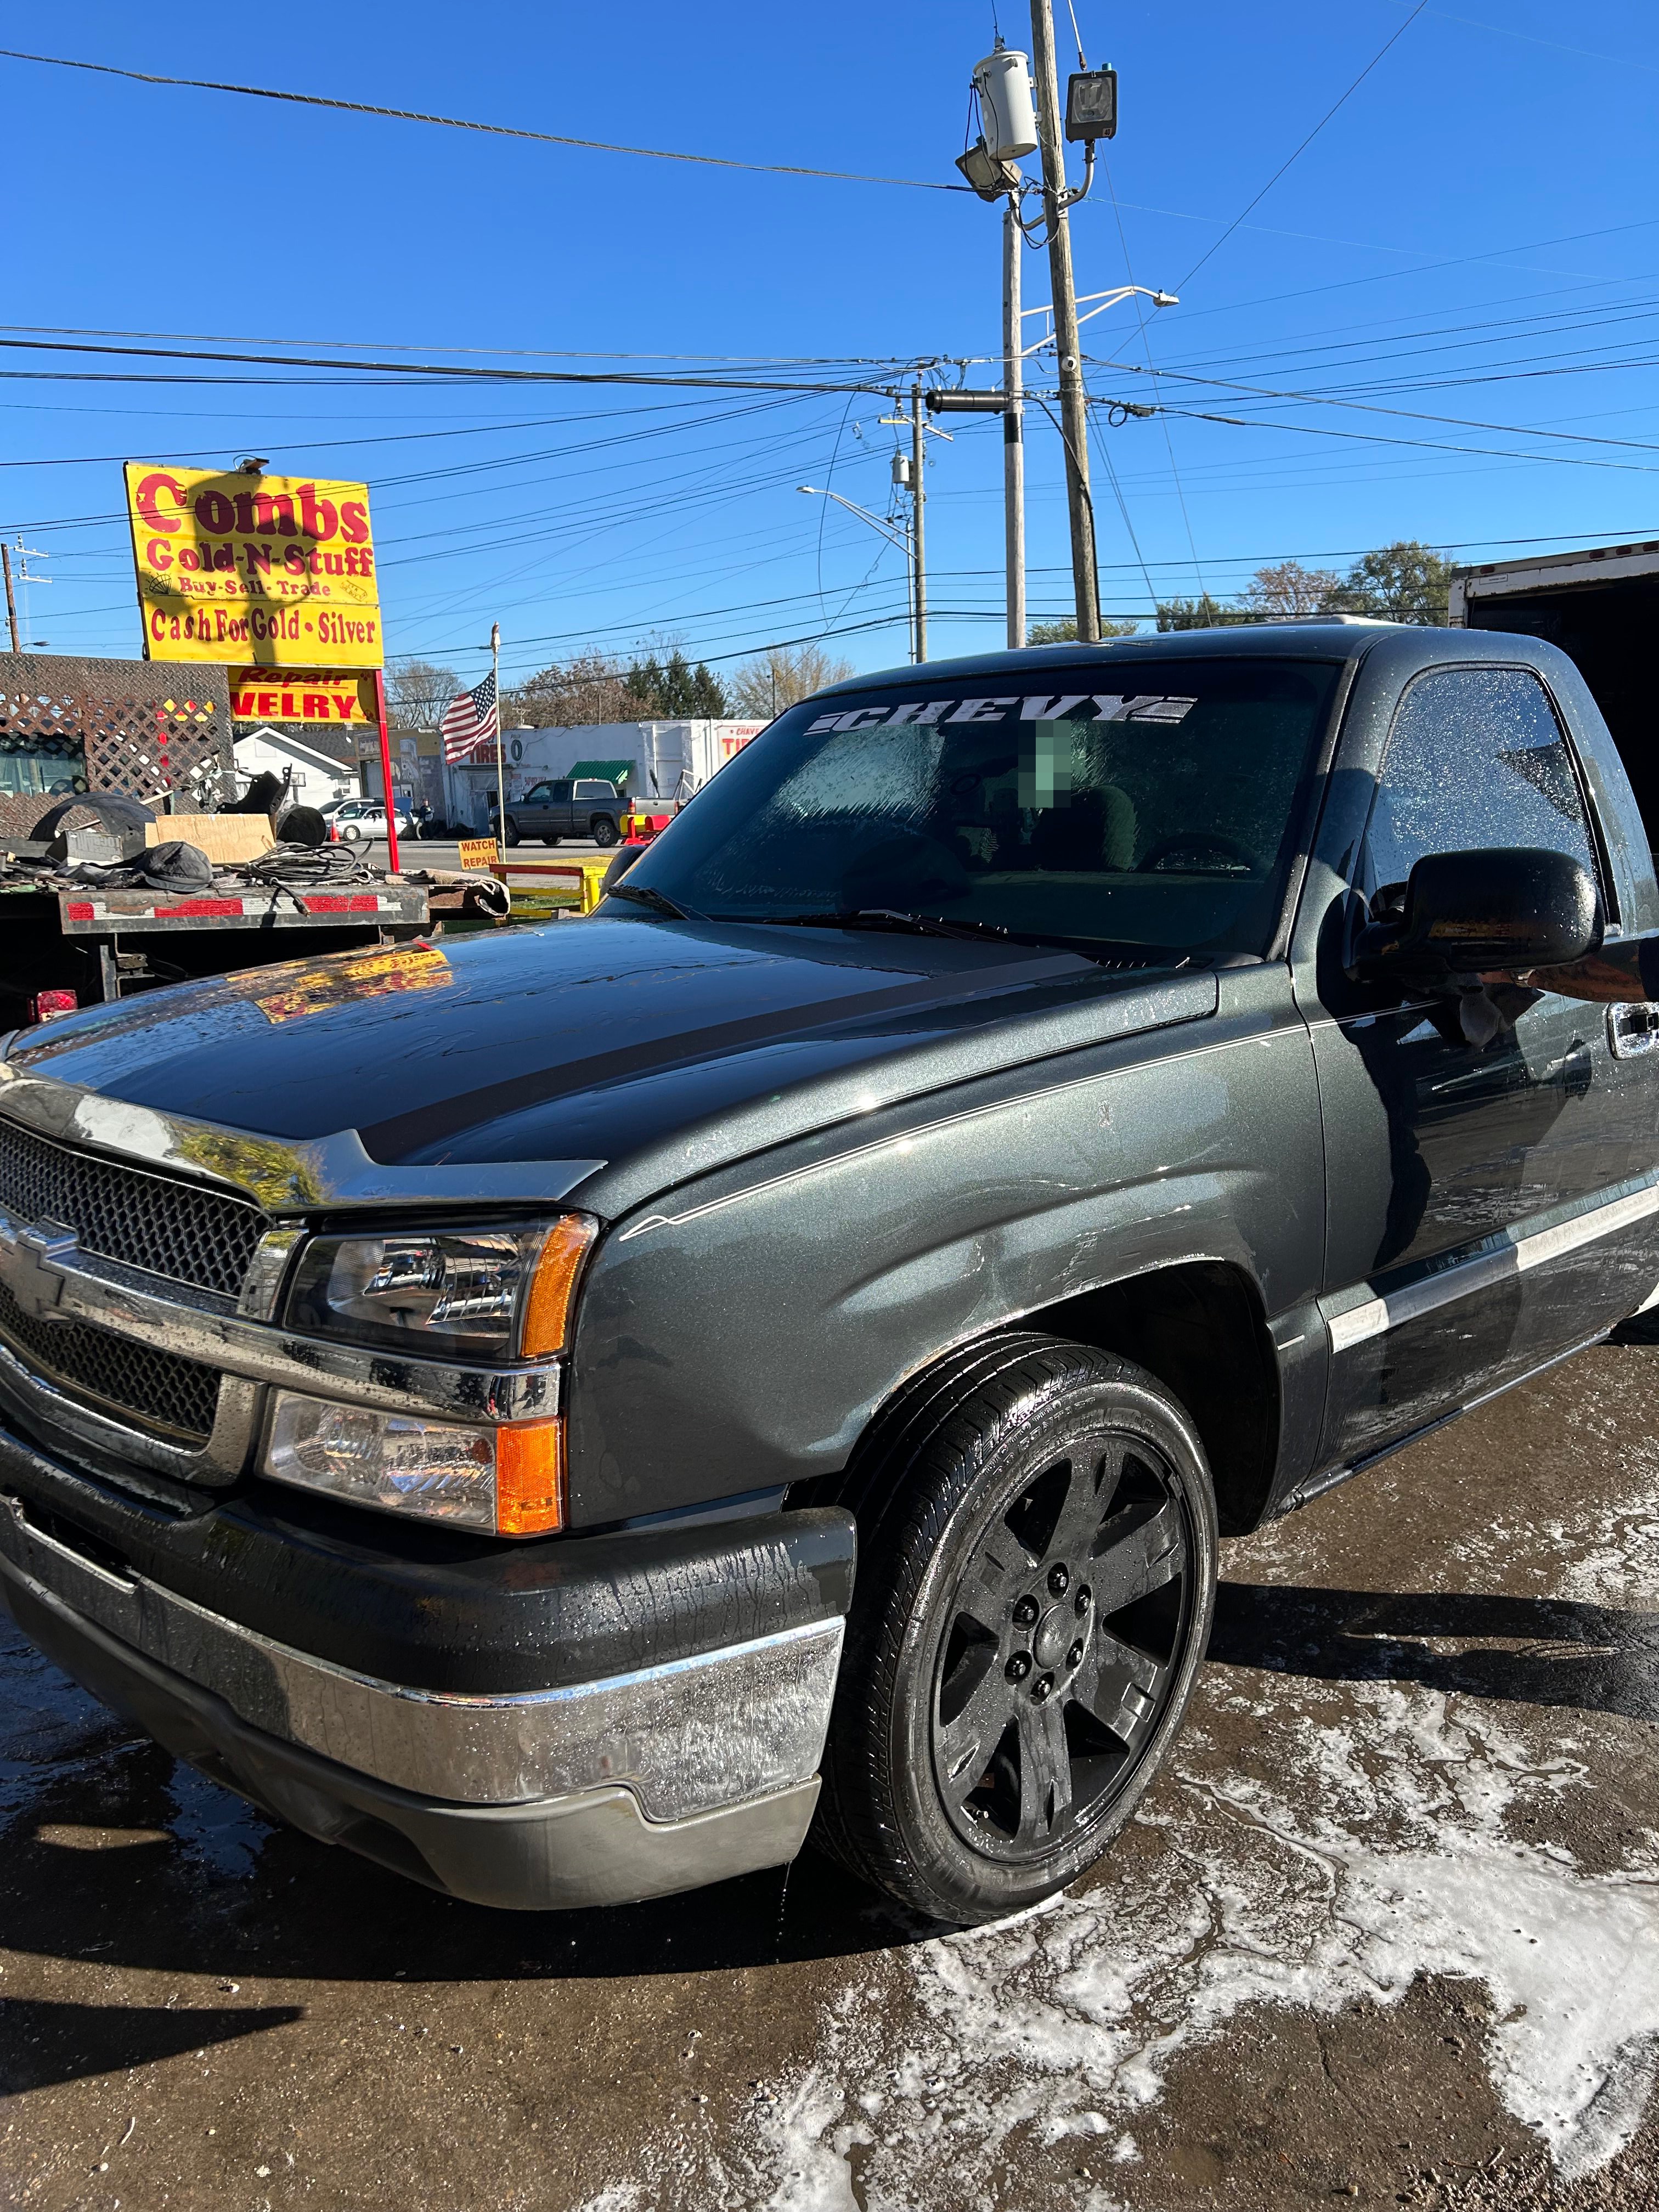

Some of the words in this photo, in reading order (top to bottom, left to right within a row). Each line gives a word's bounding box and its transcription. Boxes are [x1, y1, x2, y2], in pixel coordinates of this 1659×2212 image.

[137, 473, 369, 543] Combs
[147, 539, 374, 577] Gold-N-Stuff
[151, 608, 211, 641] Cash
[214, 609, 249, 641] For
[251, 608, 299, 641] Gold
[318, 611, 375, 644] Silver
[238, 667, 348, 687] Repair
[832, 695, 1164, 732] CHEVY
[461, 839, 495, 851] WATCH
[463, 856, 497, 868] REPAIR
